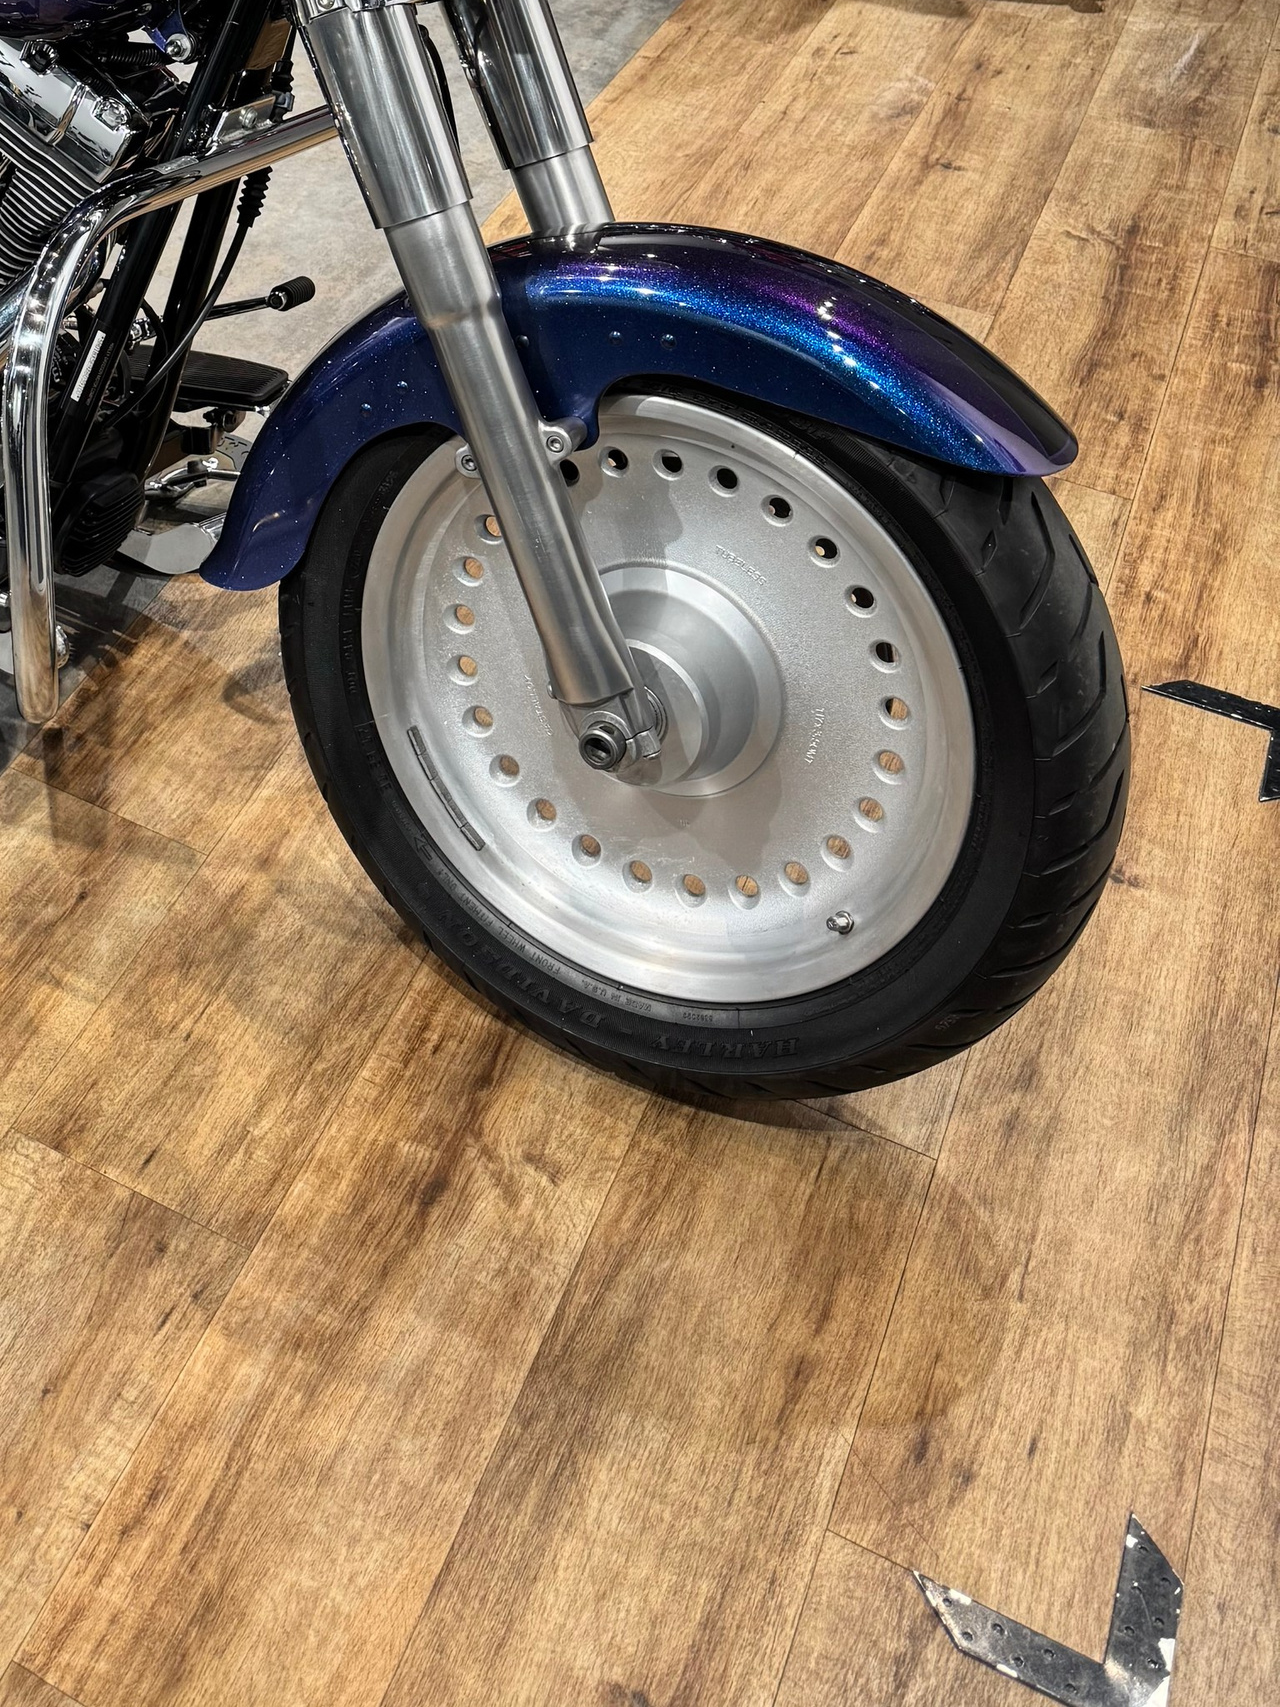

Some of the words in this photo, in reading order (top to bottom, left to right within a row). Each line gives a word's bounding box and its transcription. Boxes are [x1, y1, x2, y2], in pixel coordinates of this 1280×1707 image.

[715, 544, 768, 587] TUBELESS
[434, 866, 459, 897] ONLY
[460, 892, 493, 933] FITMENT
[494, 924, 526, 956] WHEEL
[433, 908, 603, 1030] DAVIDSON
[530, 950, 561, 976] FRONT
[648, 1032, 799, 1060] HARLEY
